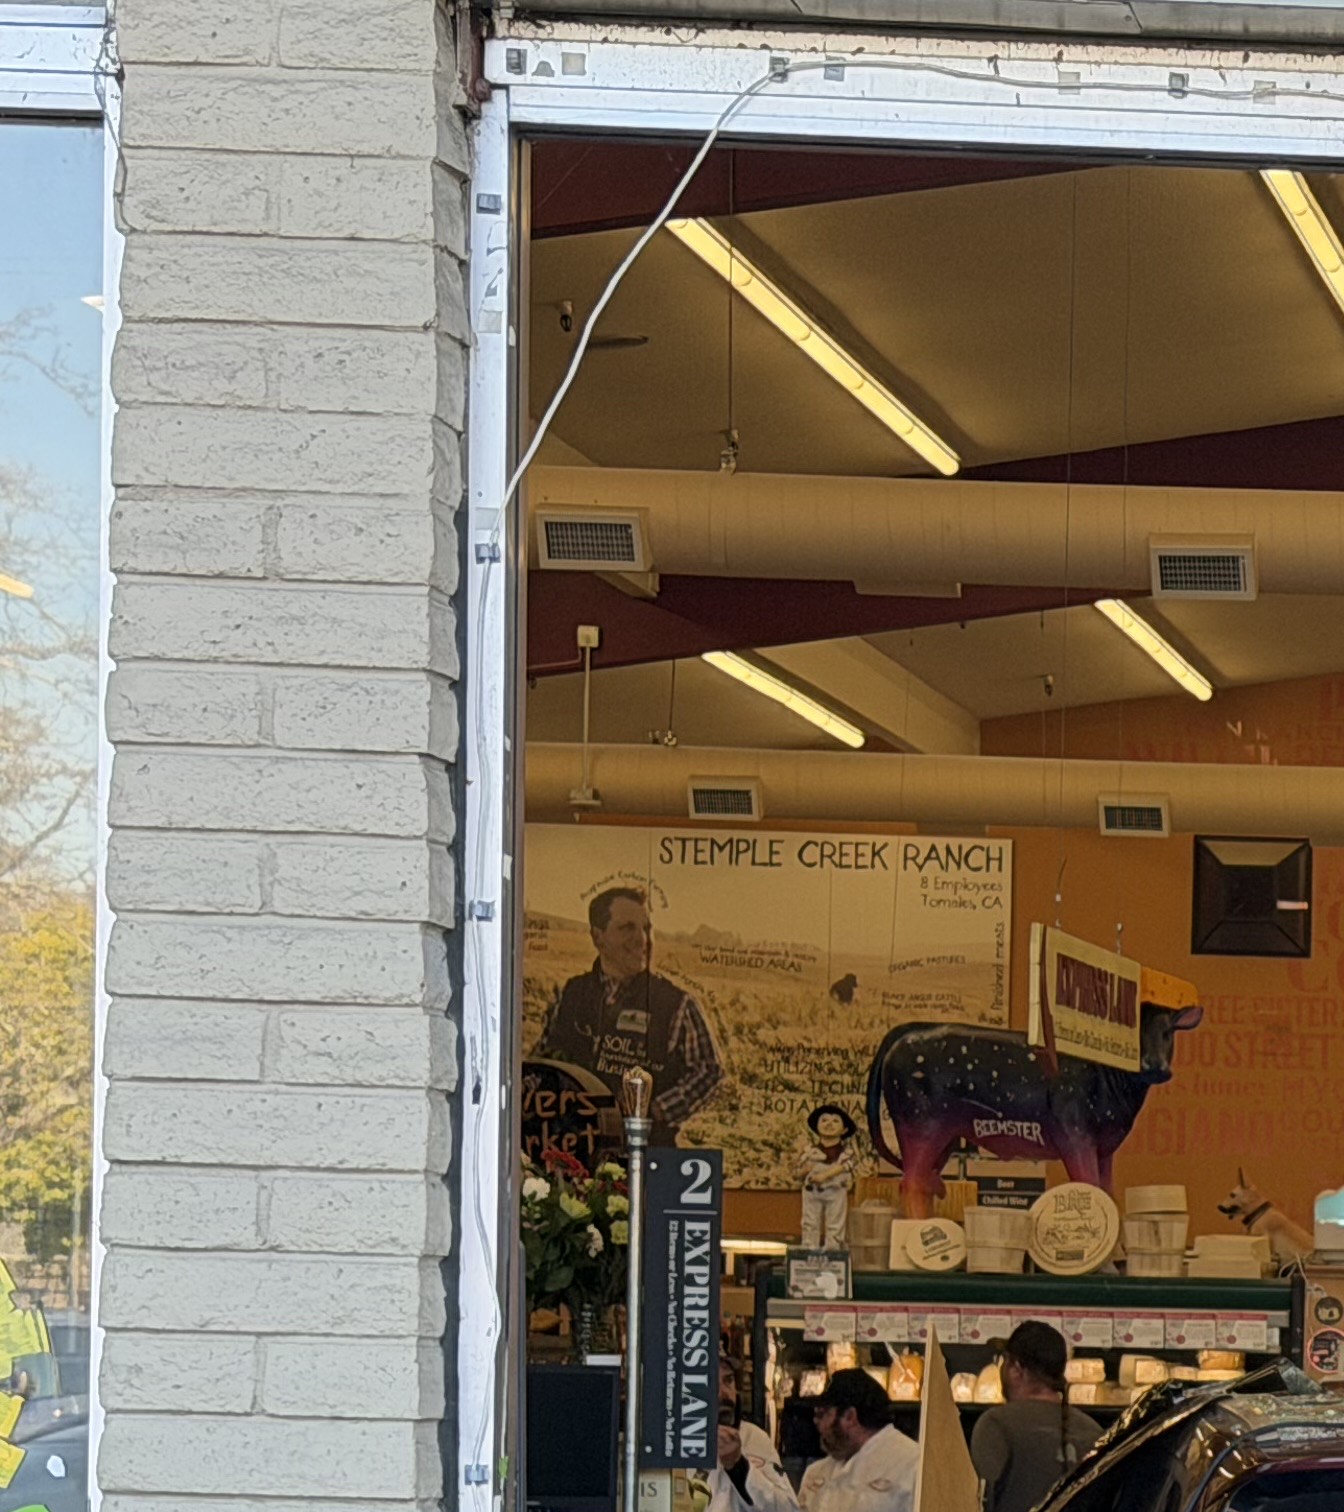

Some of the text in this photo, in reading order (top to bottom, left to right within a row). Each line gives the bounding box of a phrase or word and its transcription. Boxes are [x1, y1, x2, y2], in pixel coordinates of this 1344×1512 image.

[659, 836, 1004, 874] STEMPLE CREEK RANCH
[933, 876, 1004, 895] Employees
[980, 895, 1004, 910] CA
[602, 1034, 635, 1055] SOIL
[973, 1118, 1045, 1146] BEEMSTER
[679, 1157, 714, 1460] 2 EXPRESS LANE
